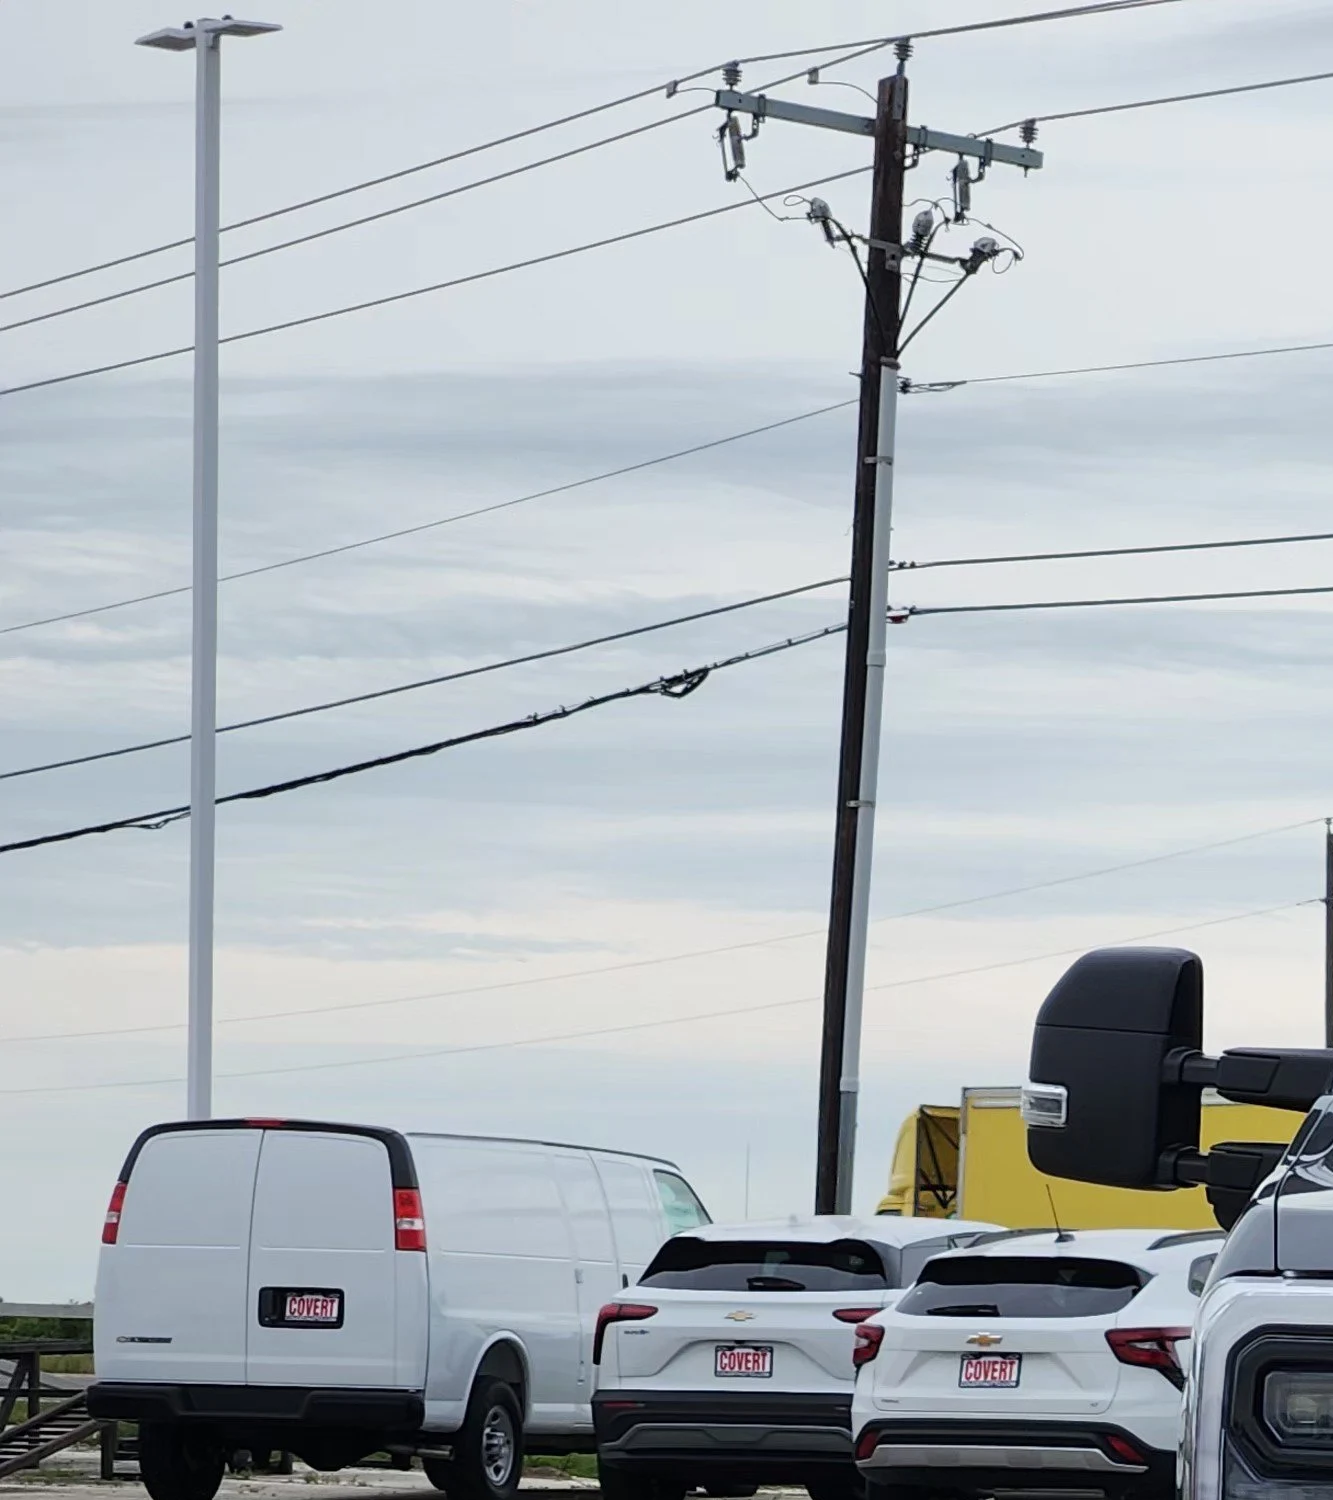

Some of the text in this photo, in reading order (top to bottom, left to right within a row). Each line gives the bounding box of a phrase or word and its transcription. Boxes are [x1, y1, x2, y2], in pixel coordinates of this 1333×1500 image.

[289, 1296, 336, 1317] COVERT
[719, 1351, 767, 1372] COVERT
[965, 1360, 1016, 1381] COVERT
